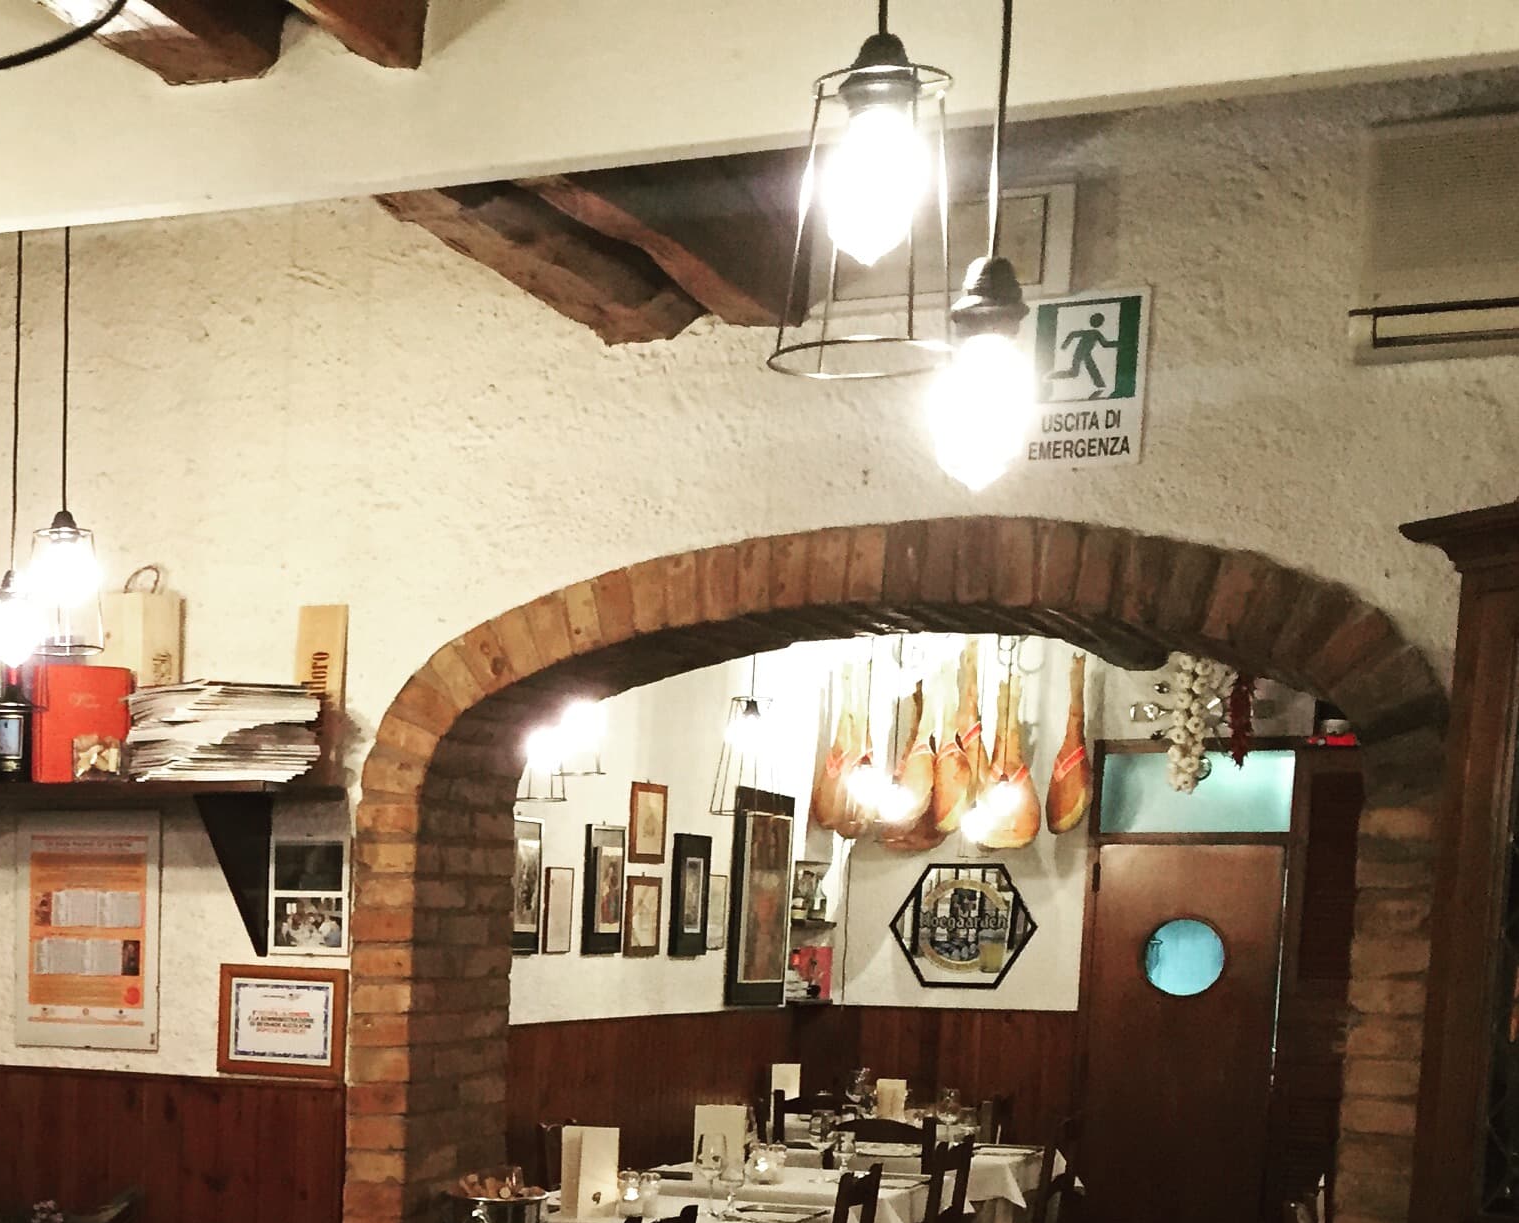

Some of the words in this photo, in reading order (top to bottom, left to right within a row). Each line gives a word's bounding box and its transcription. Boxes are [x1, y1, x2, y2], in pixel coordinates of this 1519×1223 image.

[1041, 411, 1100, 433] USCITA
[1104, 409, 1121, 429] DI
[1028, 435, 1130, 461] EMERGENZA
[919, 910, 1009, 932] Hoegaarden
